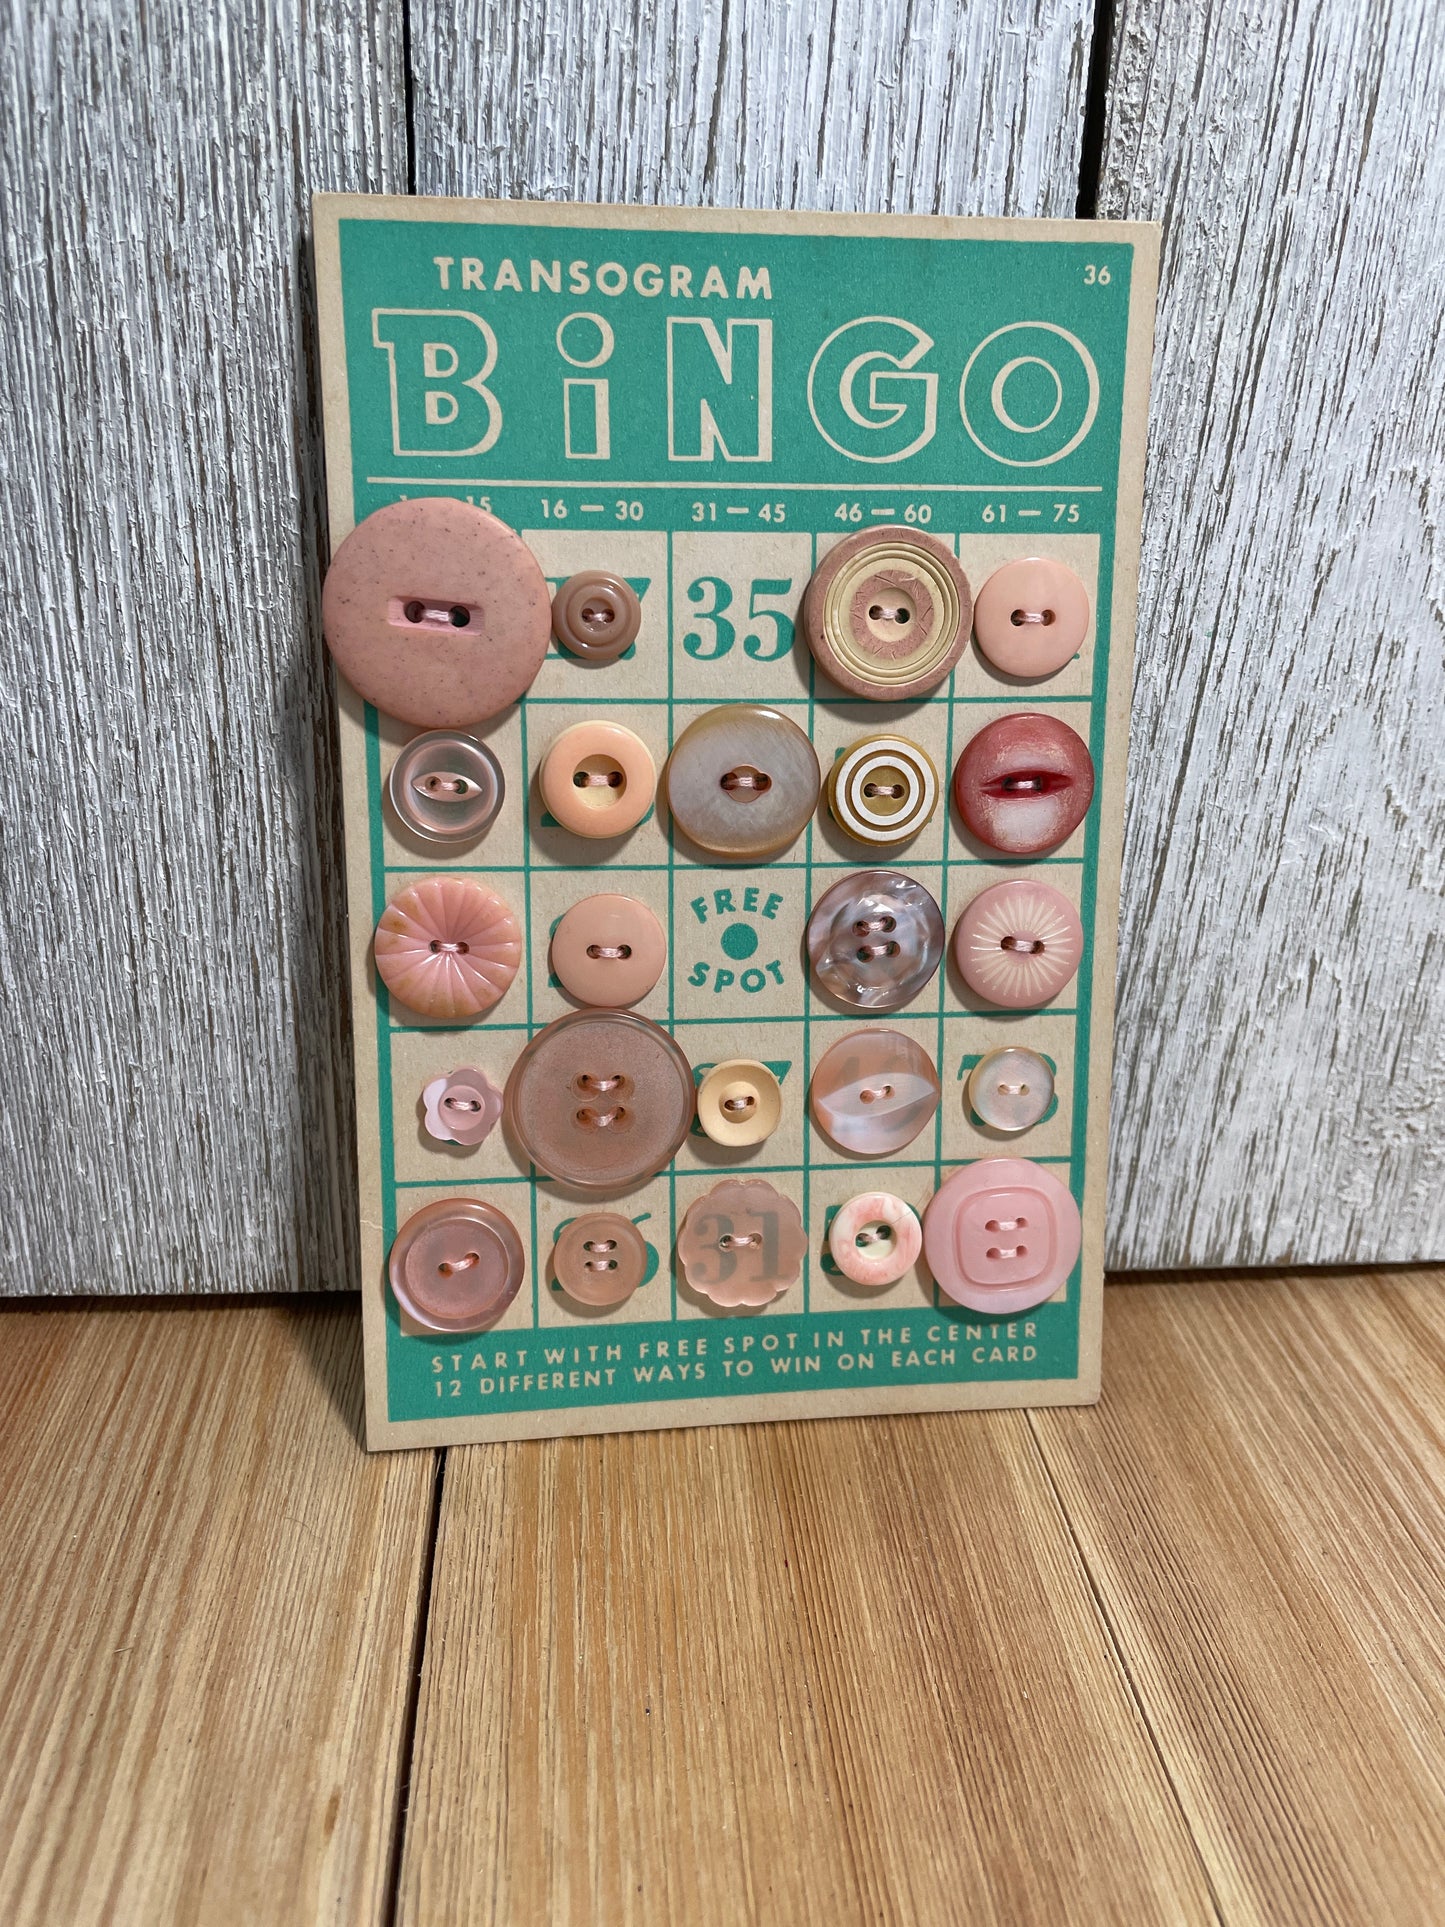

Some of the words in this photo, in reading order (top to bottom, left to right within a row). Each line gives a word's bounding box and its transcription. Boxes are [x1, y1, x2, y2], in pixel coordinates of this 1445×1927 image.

[433, 256, 772, 300] TRANSOGRAM
[1083, 264, 1111, 285] 36
[541, 499, 568, 519] 16
[615, 500, 644, 521] 30
[692, 501, 717, 522] 31
[758, 503, 786, 523] 45
[834, 503, 863, 523] 46
[903, 504, 932, 523] 60
[982, 504, 1006, 523] 61
[1053, 504, 1080, 523] 75
[683, 576, 796, 662] 35
[690, 886, 784, 924] FREE
[687, 959, 785, 993] SPOT
[431, 1350, 527, 1374] START
[544, 1344, 622, 1366] WITH
[639, 1338, 708, 1359] FREE
[723, 1332, 798, 1354] SPOT
[813, 1331, 844, 1348] IN
[860, 1327, 912, 1345] THE
[926, 1322, 1038, 1343] CENTER
[434, 1379, 462, 1398] 12
[480, 1368, 617, 1395] DIFFERENT
[633, 1363, 706, 1384] WAYS
[722, 1360, 754, 1377] TO
[770, 1356, 821, 1374] WIN
[837, 1353, 875, 1370] ON
[891, 1350, 955, 1368] EACH
[971, 1345, 1038, 1364] CARD
